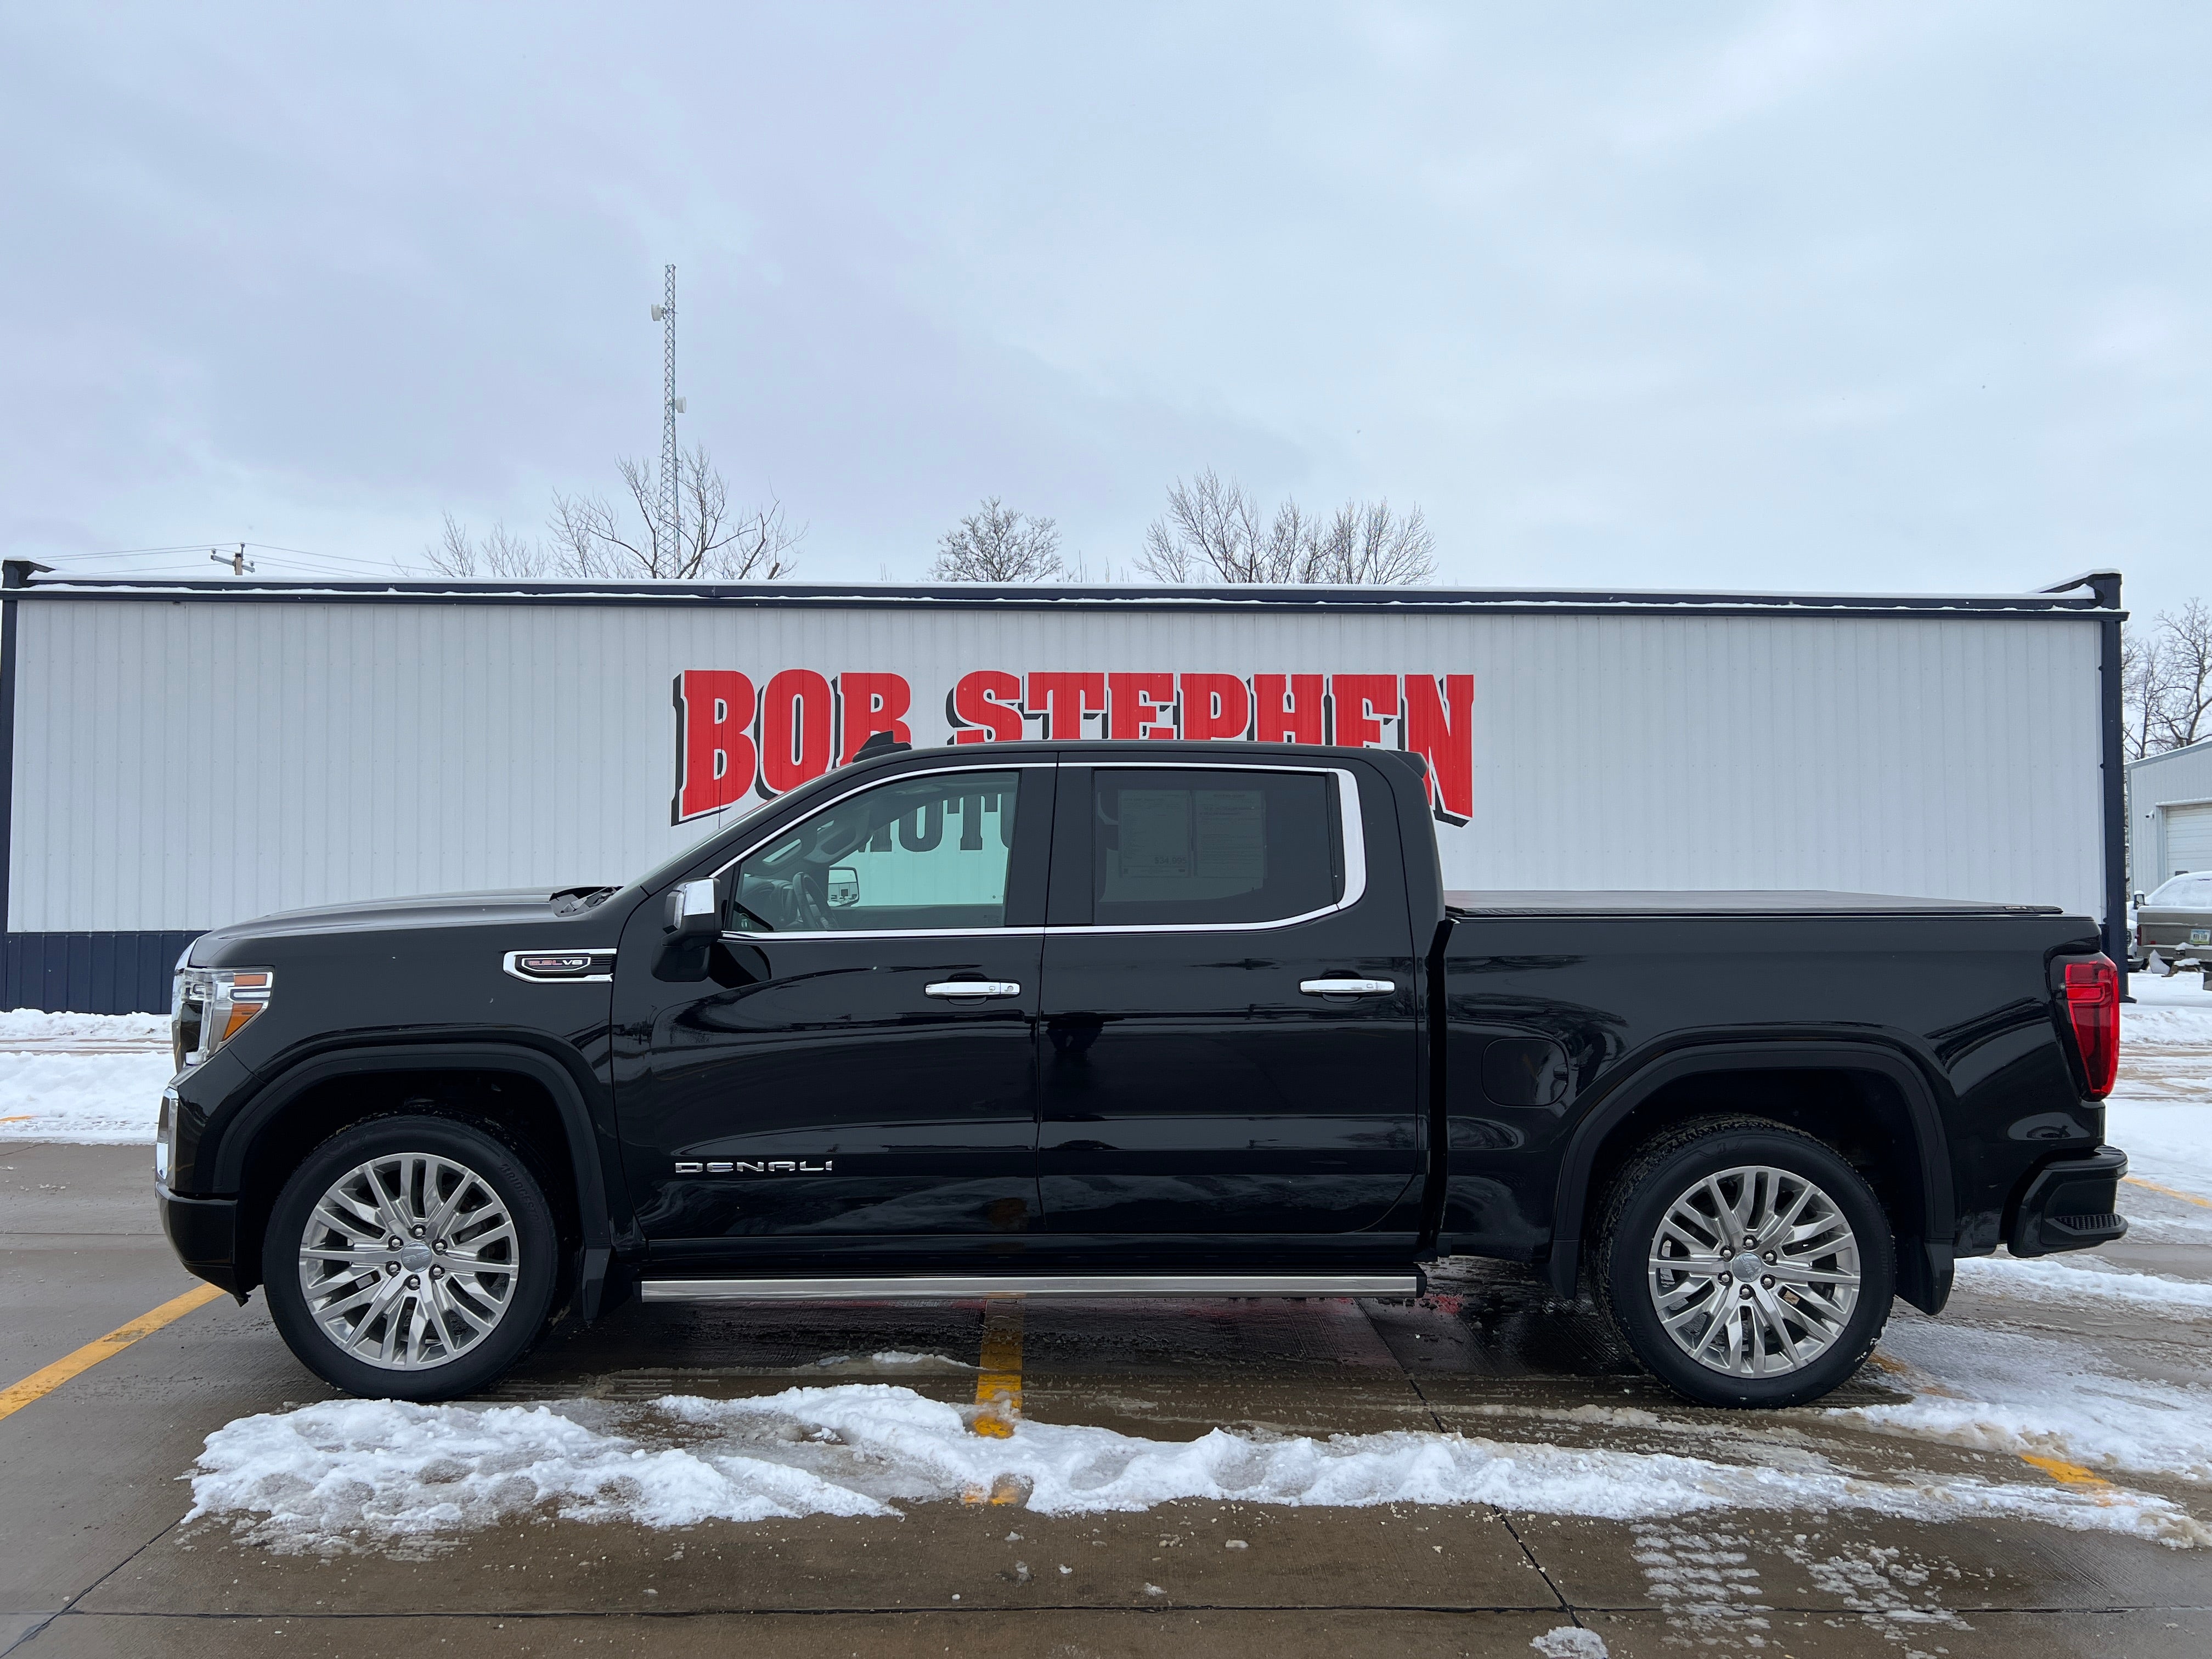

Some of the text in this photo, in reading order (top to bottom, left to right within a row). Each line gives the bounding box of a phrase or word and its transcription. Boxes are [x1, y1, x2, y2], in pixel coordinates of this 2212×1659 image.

[678, 669, 1475, 819] BOB STEPHEN
[675, 1160, 833, 1173] DENALI
[403, 1250, 430, 1264] GMC
